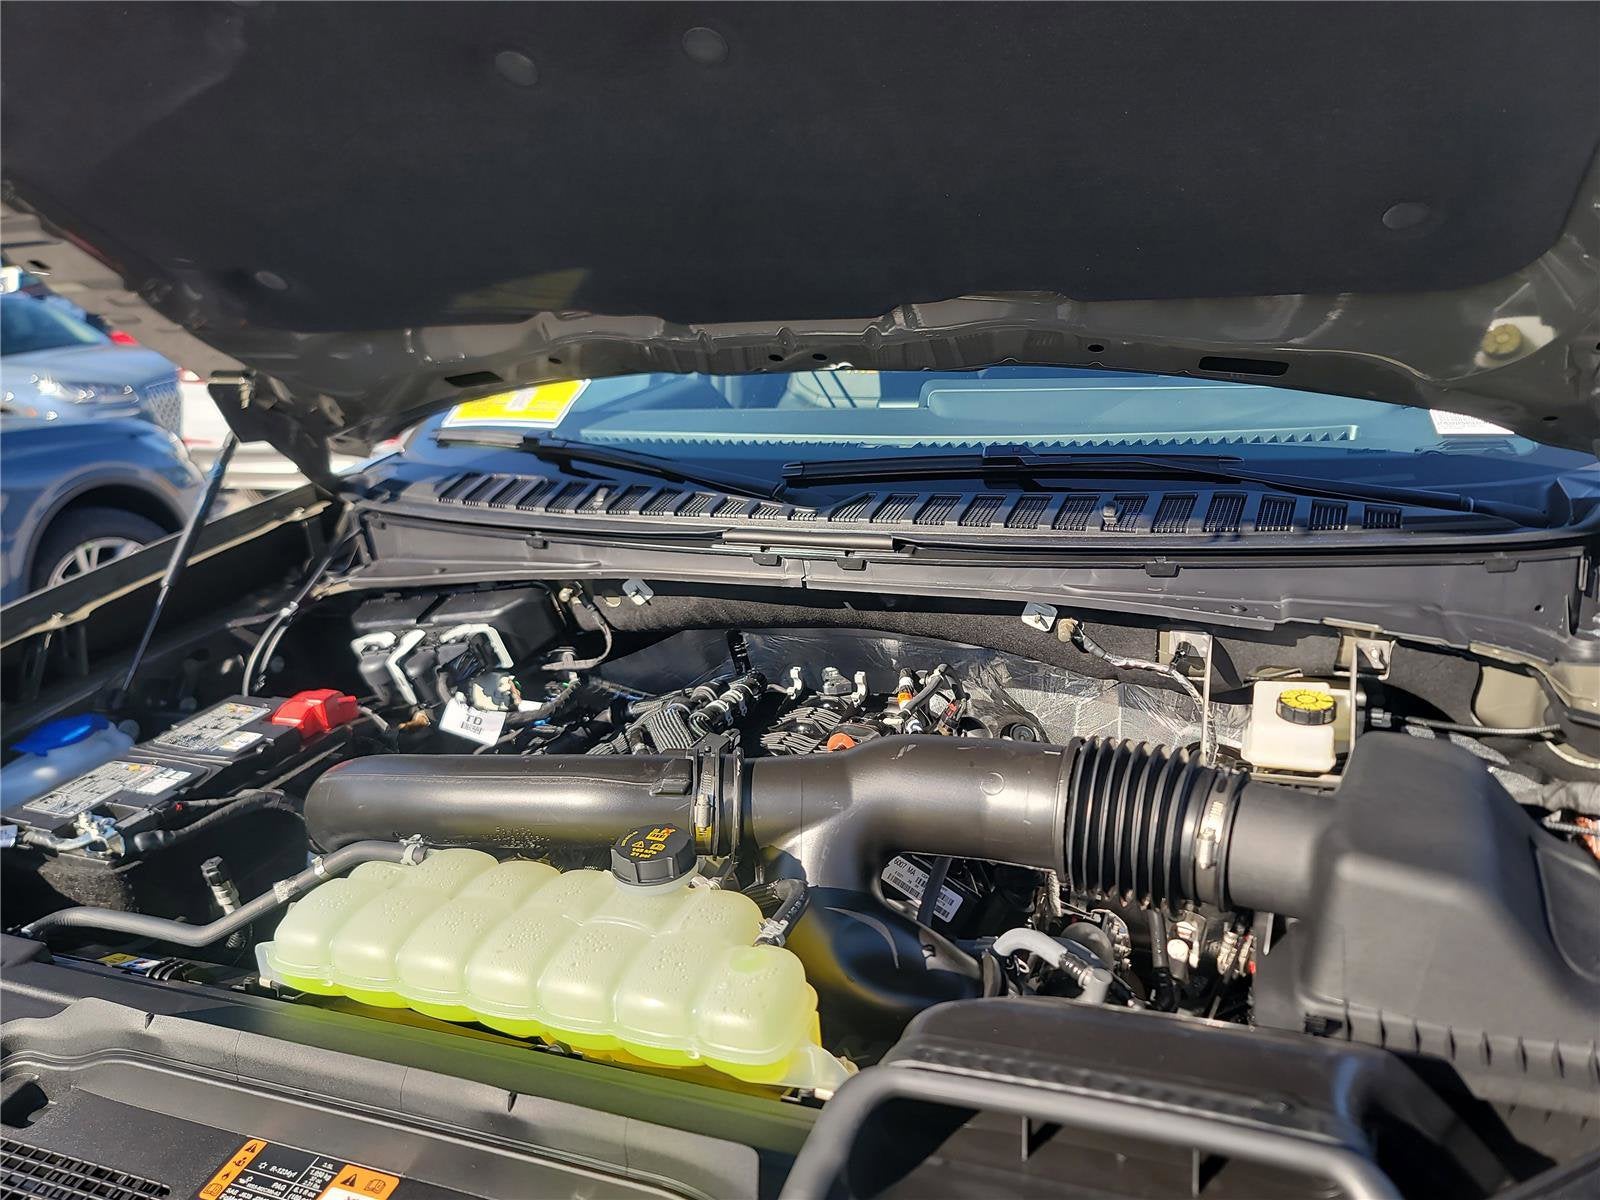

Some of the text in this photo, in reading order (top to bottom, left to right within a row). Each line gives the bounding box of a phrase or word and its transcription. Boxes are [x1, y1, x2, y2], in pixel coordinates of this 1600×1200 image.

[467, 714, 482, 725] TD
[908, 866, 916, 876] MA
[269, 1166, 298, 1178] R-1234yf
[271, 1182, 287, 1191] PAG
